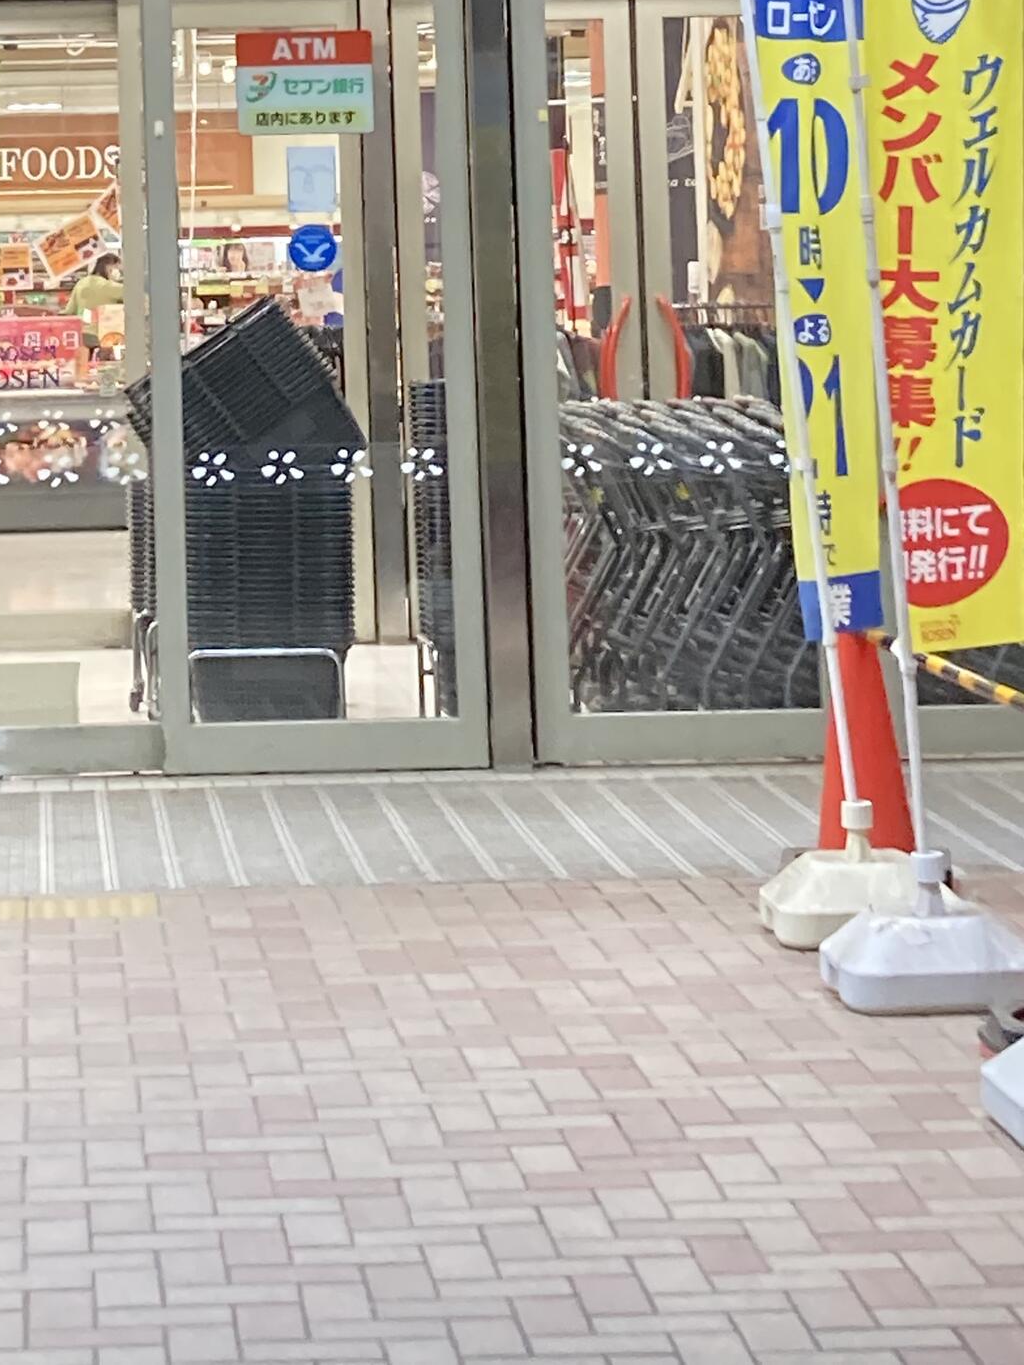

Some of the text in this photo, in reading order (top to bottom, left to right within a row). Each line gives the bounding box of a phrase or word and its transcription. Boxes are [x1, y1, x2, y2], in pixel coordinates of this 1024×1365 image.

[272, 37, 336, 61] ATM
[283, 78, 364, 95] セブン銀行
[256, 111, 357, 127] 店内にあります
[798, 318, 830, 343] よる
[904, 544, 989, 584] 発行!!
